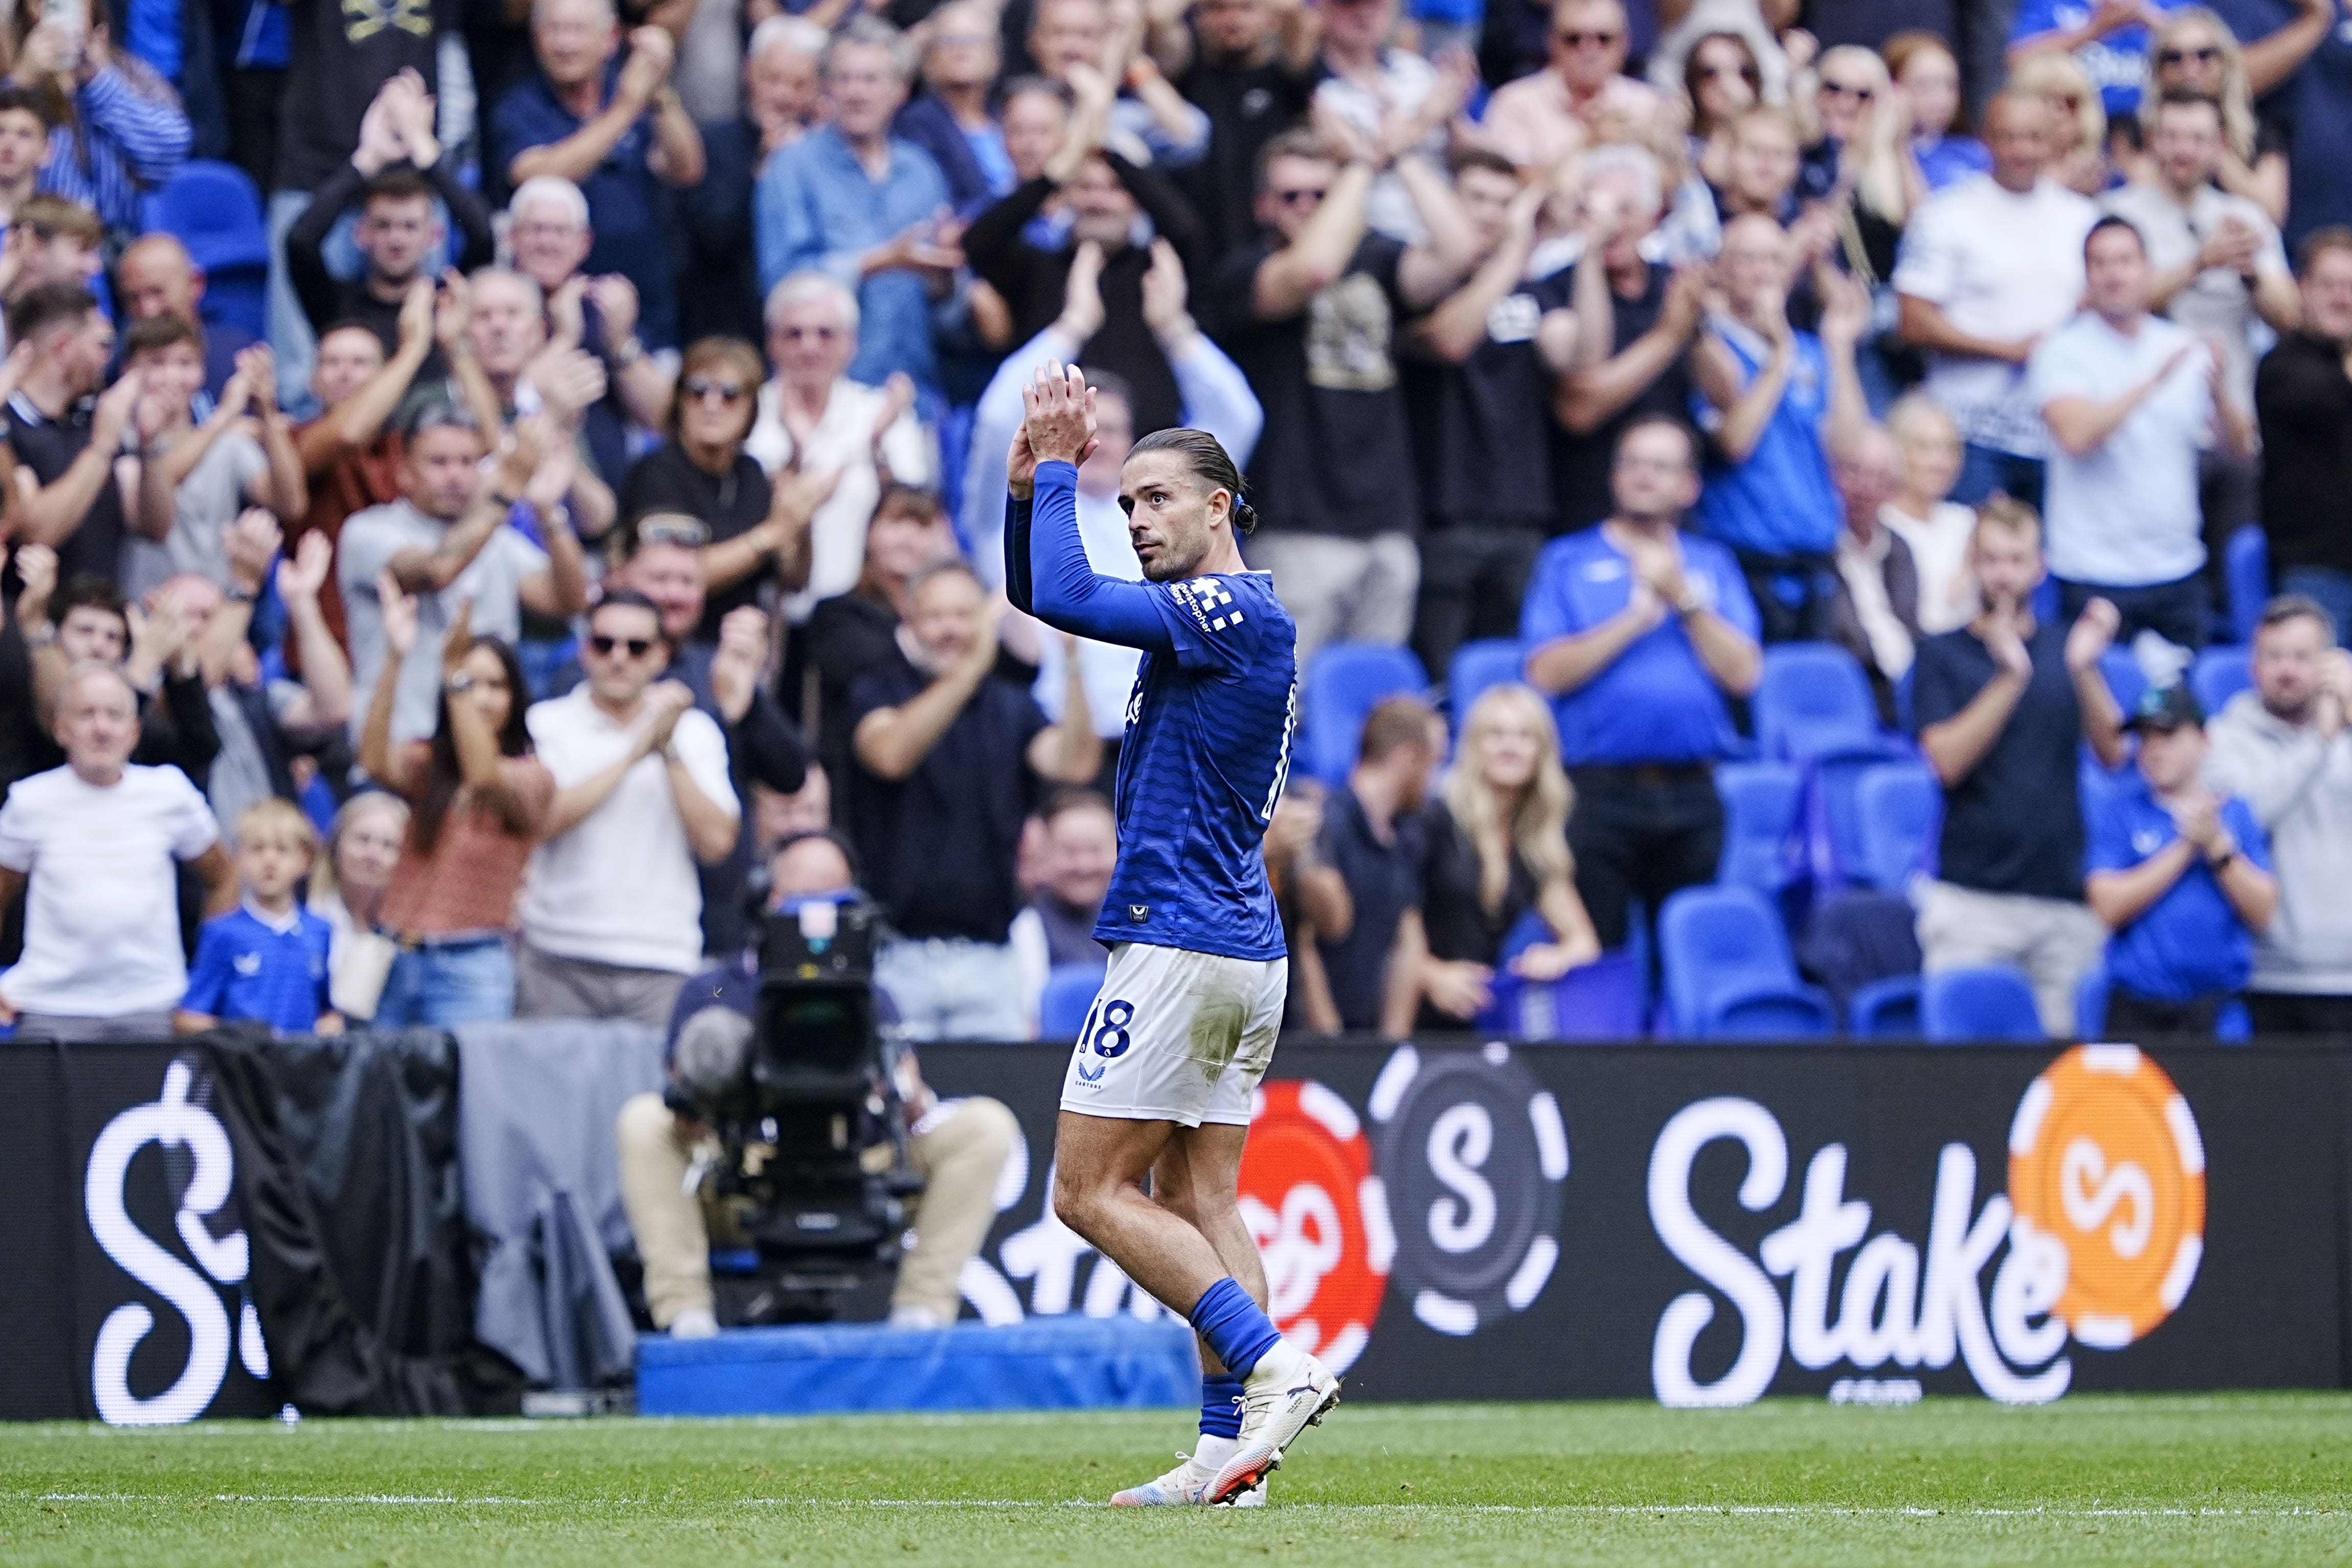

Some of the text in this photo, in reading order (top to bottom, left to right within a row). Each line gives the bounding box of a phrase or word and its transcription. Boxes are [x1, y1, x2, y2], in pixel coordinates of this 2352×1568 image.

[1079, 998, 1135, 1058] 18
[1075, 1080, 1101, 1090] CASTORE
[1647, 1095, 2073, 1408] Stake
